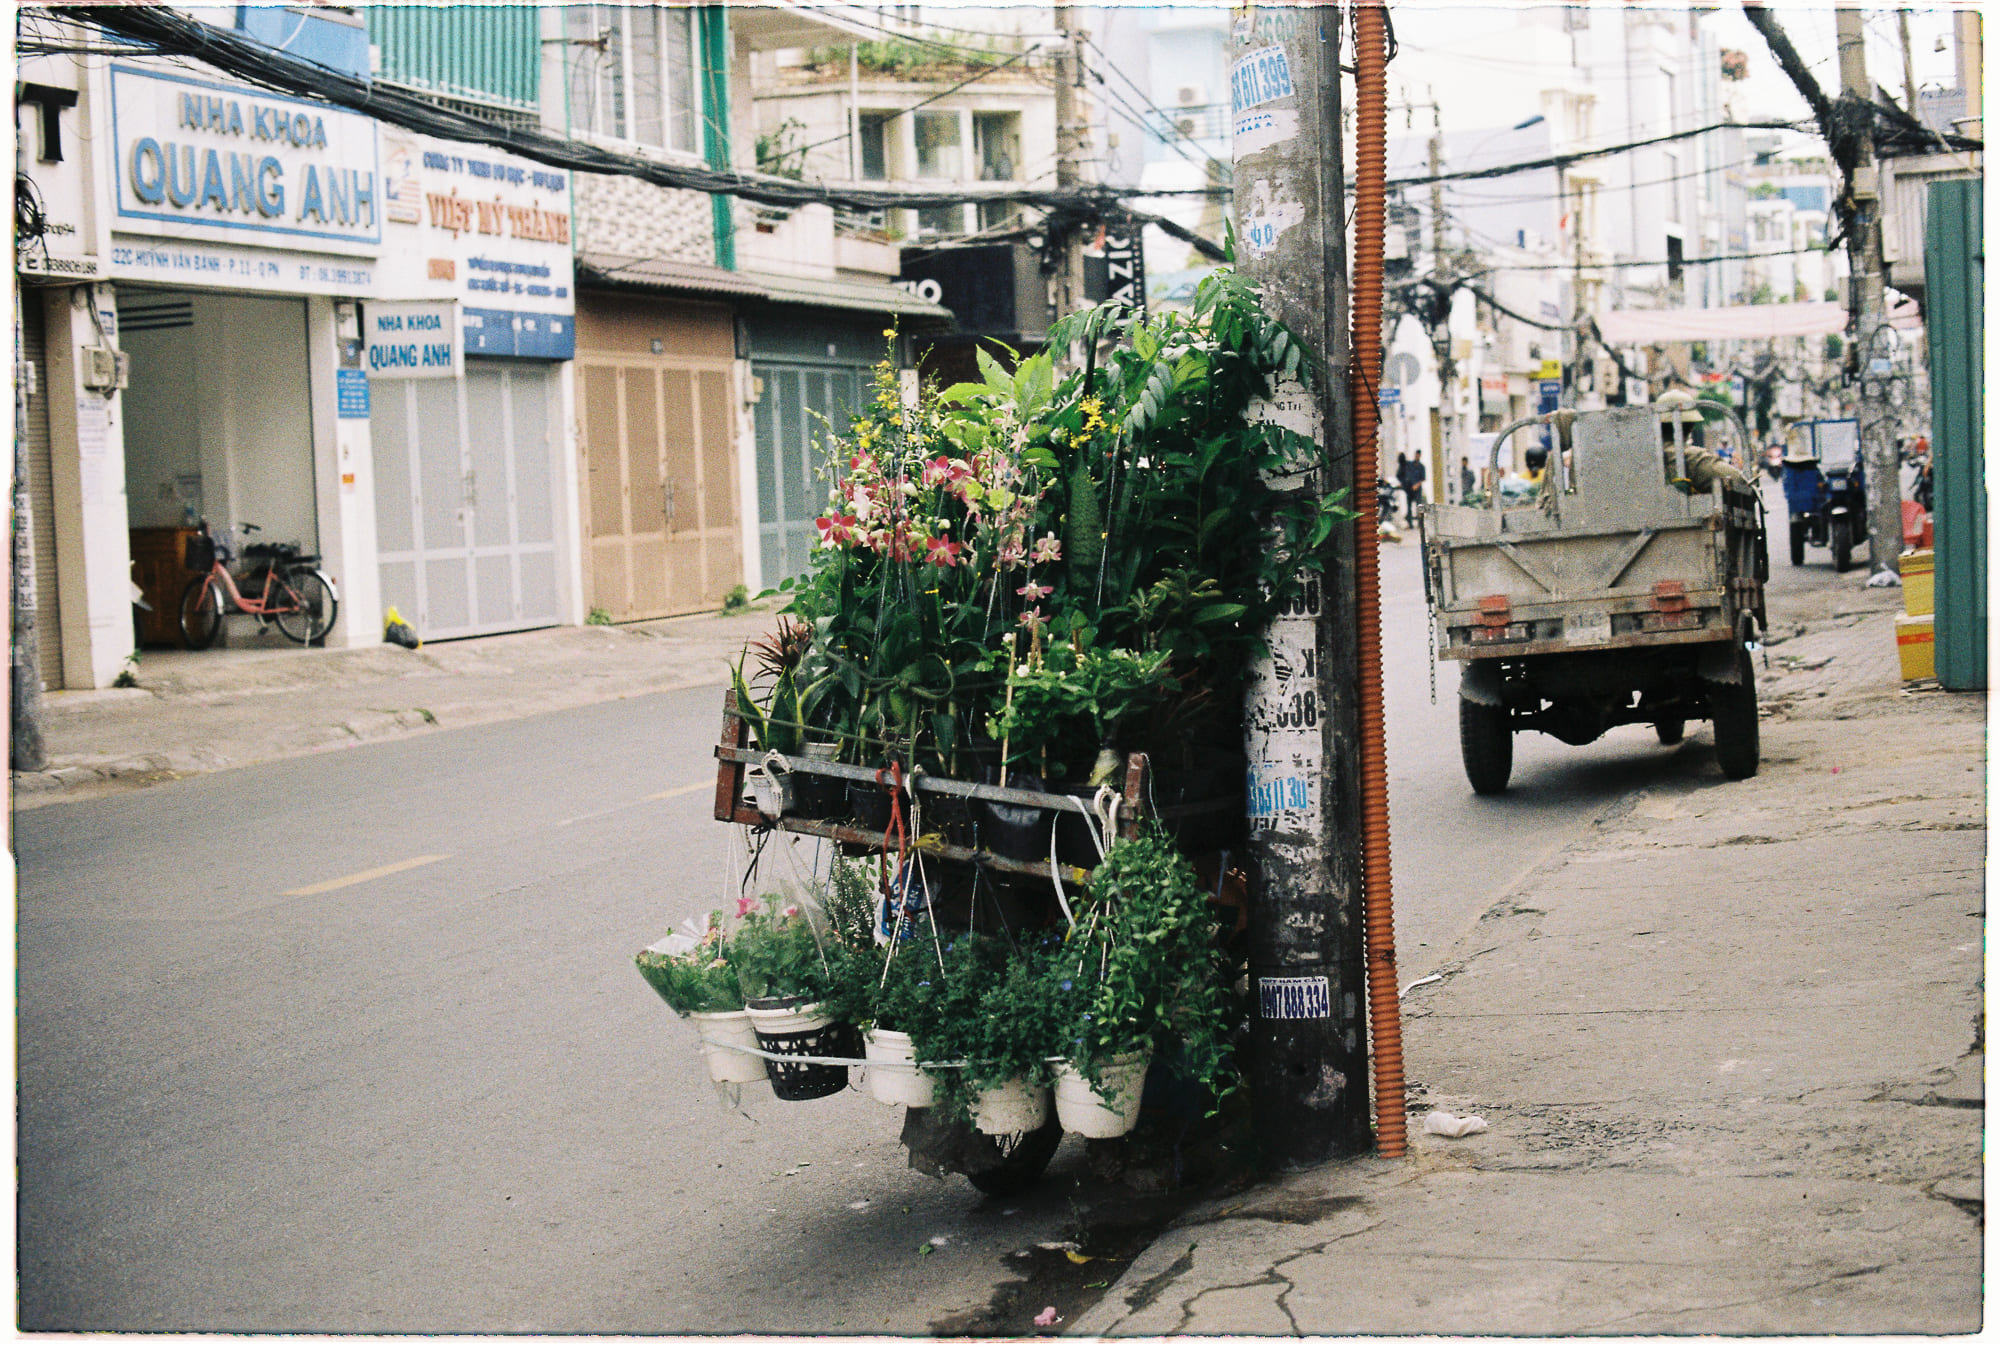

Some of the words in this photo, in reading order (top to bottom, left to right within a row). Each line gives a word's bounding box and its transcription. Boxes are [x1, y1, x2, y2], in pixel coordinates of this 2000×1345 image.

[179, 92, 244, 136] NHA
[250, 105, 328, 149] KHOA
[131, 137, 285, 219] QUANG
[299, 164, 375, 226] ANH
[377, 315, 403, 332] NHA
[407, 314, 442, 331] KHOA
[369, 343, 418, 371] QUANG
[422, 343, 451, 367] ANH
